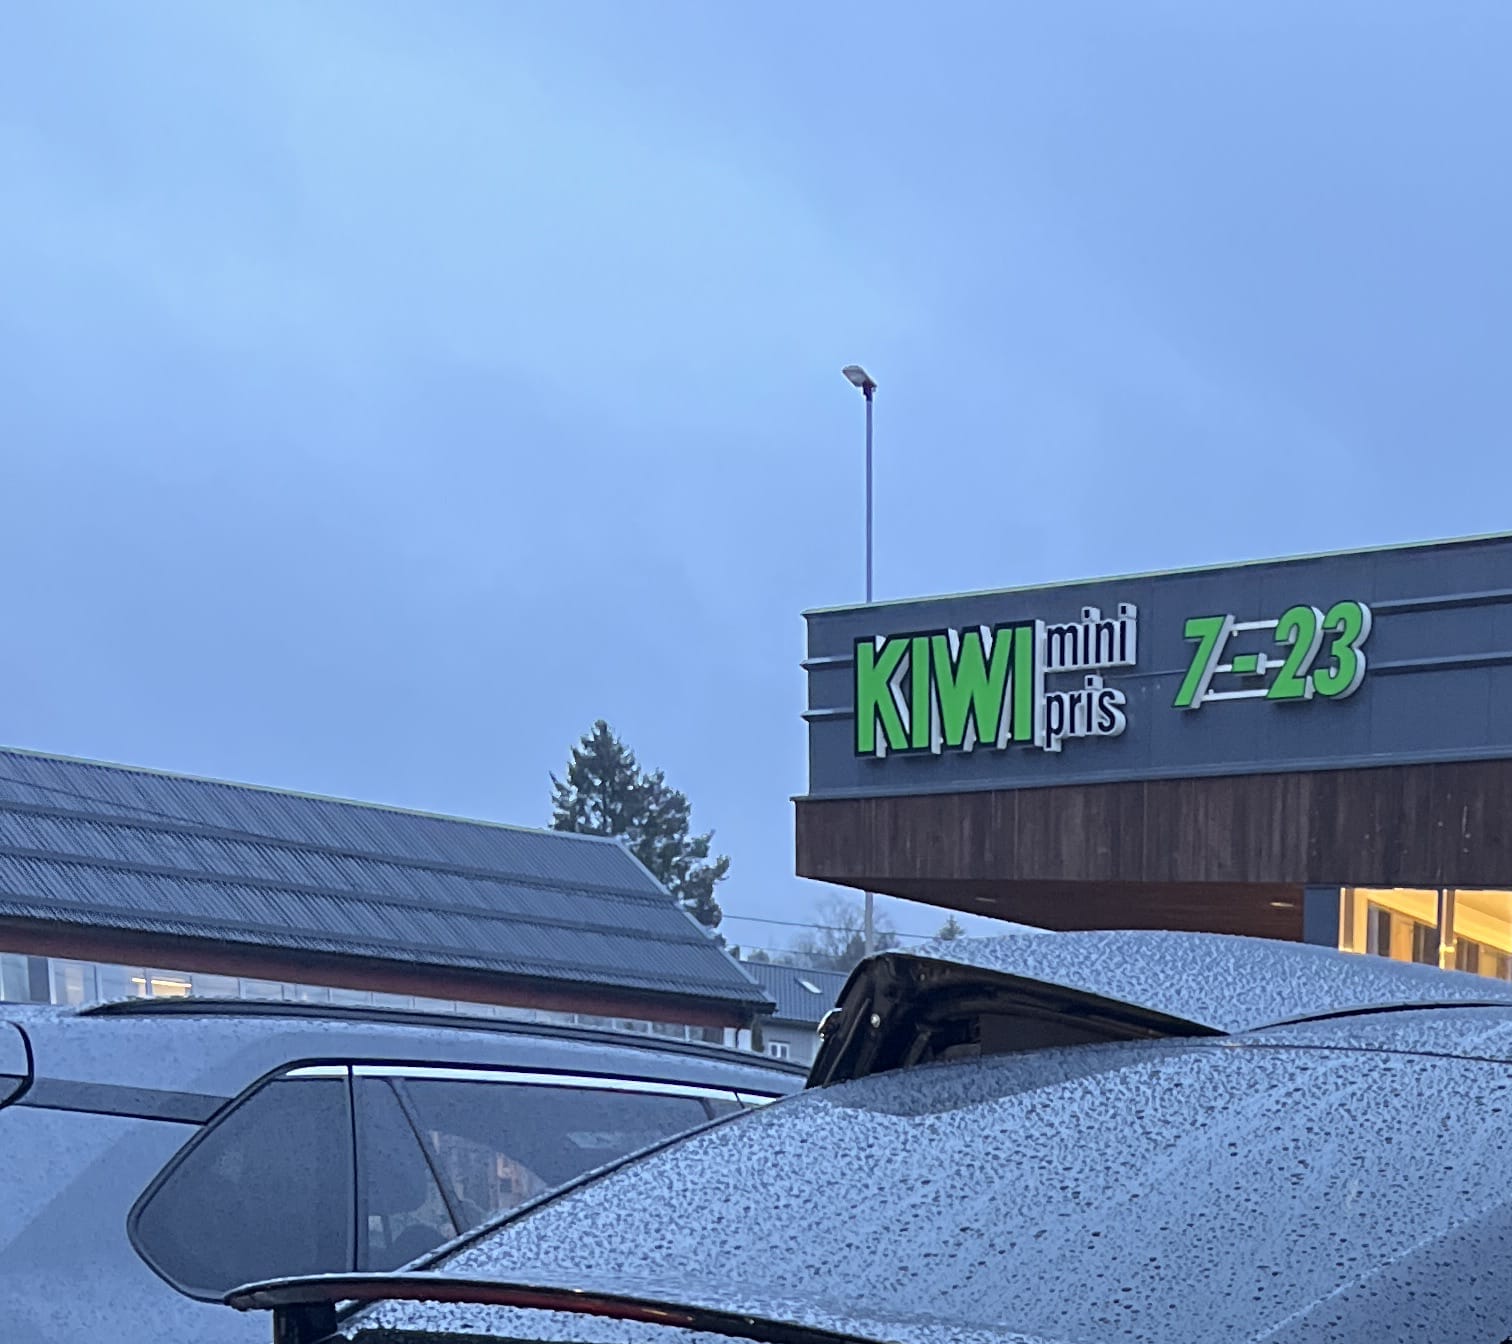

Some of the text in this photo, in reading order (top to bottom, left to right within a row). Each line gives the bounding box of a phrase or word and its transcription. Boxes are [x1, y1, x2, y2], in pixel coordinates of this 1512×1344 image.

[1045, 604, 1133, 669] mini
[1172, 600, 1367, 708] 7-23
[854, 622, 1040, 757] KIWI
[1045, 675, 1123, 750] pris
